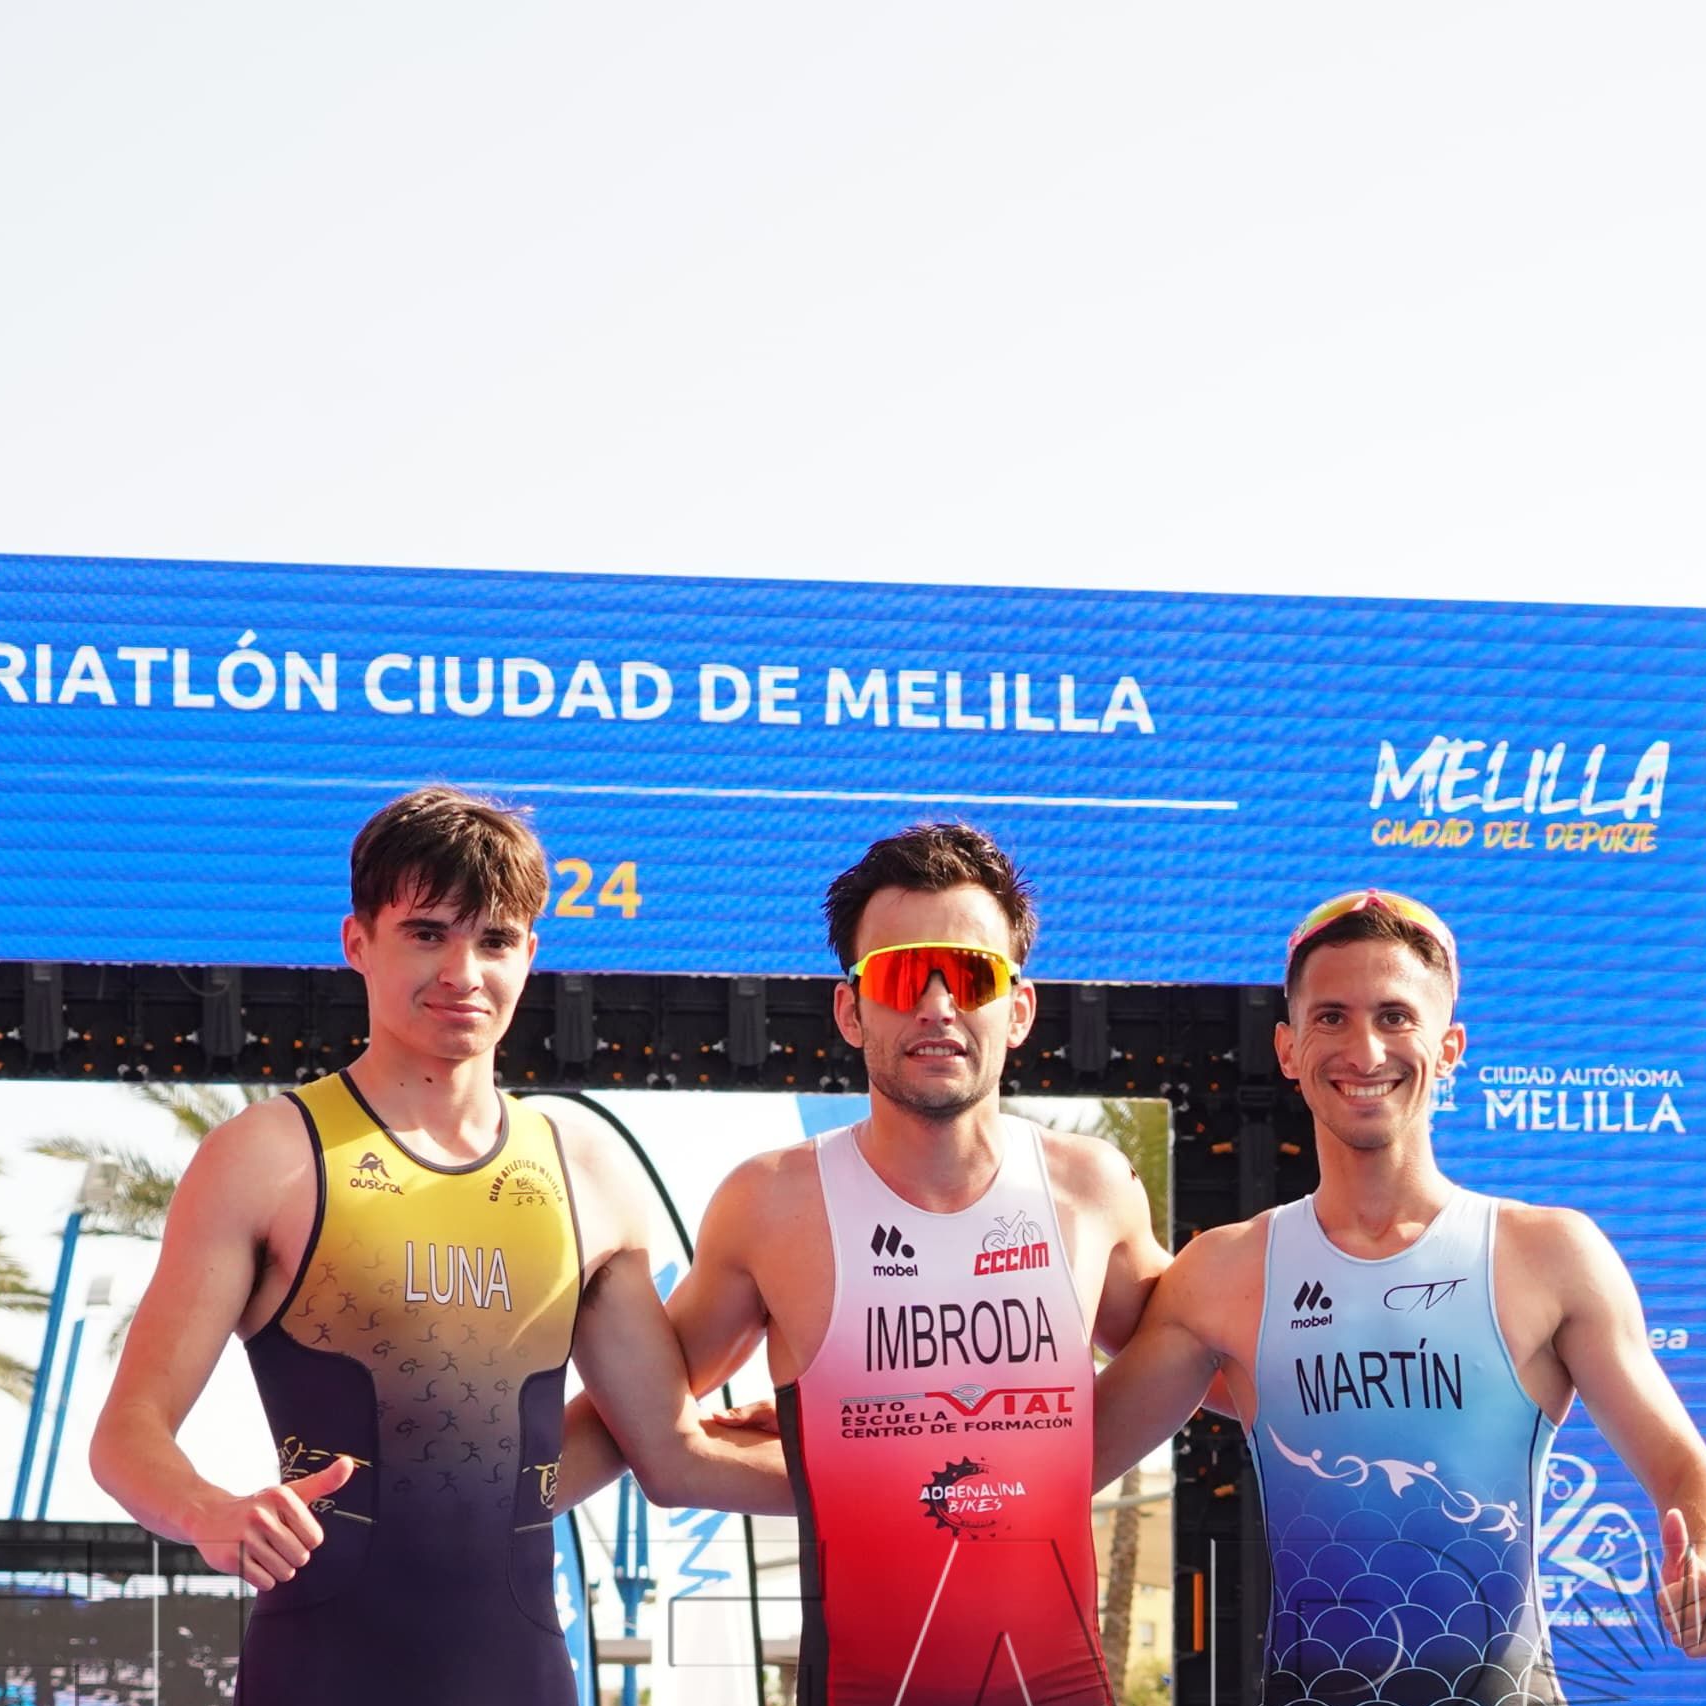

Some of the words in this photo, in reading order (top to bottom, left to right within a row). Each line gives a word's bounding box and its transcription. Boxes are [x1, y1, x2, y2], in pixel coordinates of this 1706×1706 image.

[364, 653, 673, 720] CIUDAD
[698, 663, 801, 725] DE
[824, 667, 1155, 734] MELILLA
[1370, 735, 1670, 820] MELILLA
[1372, 818, 1475, 848] CIUDAD
[1483, 821, 1535, 849] DEL
[1545, 821, 1659, 853] DEPORTE
[554, 857, 642, 919] 24
[1479, 1065, 1556, 1086] CIUDAD
[1562, 1063, 1684, 1089] AUTÓNOMA
[1483, 1087, 1686, 1133] MELILLA
[488, 1176, 505, 1203] CLUB
[501, 1159, 538, 1180] ATLÉTICO
[404, 1240, 513, 1312] LUNA
[873, 1263, 918, 1277] mobel
[973, 1241, 1050, 1276] CCCAM
[865, 1296, 1059, 1372] IMBRODA
[1290, 1313, 1333, 1330] mobel
[1295, 1337, 1463, 1416] MARTÍN
[840, 1402, 905, 1415] AUTO
[841, 1410, 948, 1427] ESCUELA
[841, 1425, 924, 1439] CENTRO
[930, 1421, 957, 1434] DE
[964, 1415, 1073, 1432] FORMACIÓN
[919, 1481, 1026, 1501] ADRENALINA
[947, 1498, 1003, 1514] BIKES
[1539, 1574, 1578, 1599] ET
